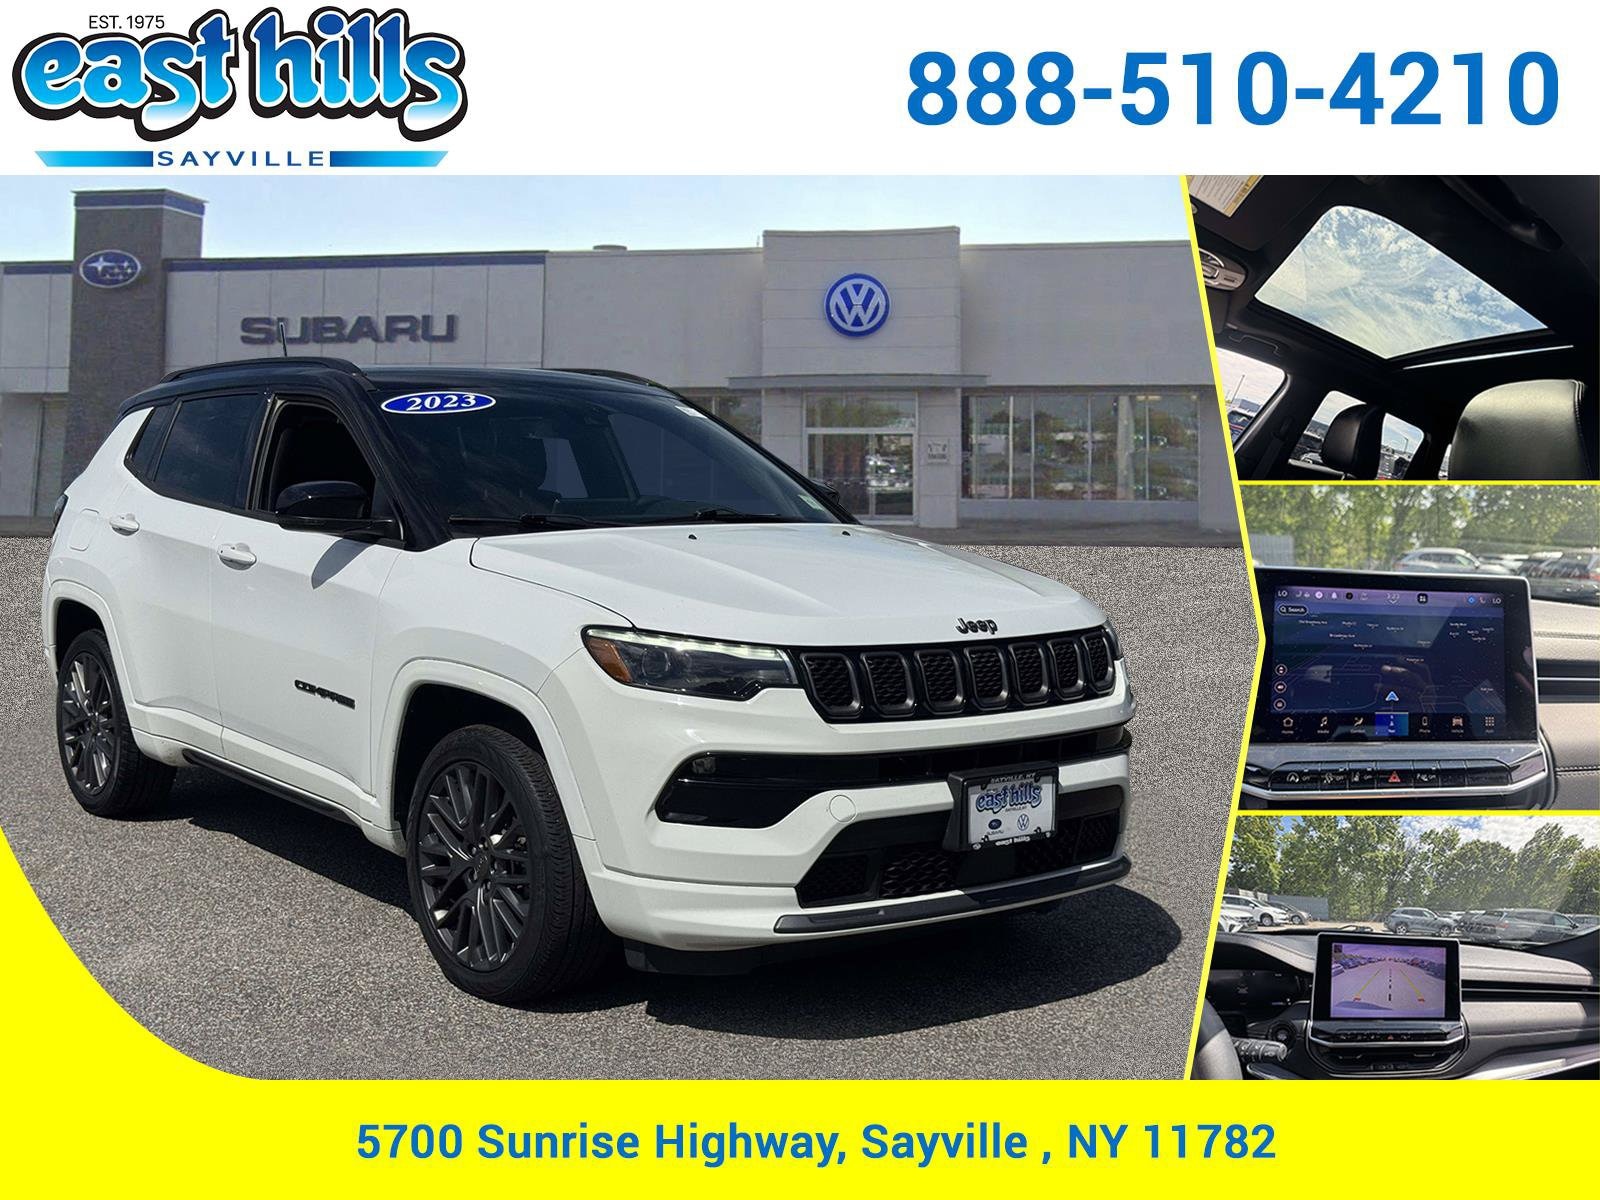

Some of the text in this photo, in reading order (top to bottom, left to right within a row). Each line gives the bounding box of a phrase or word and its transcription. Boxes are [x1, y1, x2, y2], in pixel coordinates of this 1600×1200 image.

[240, 314, 458, 345] SUBARU
[406, 393, 477, 411] 2023
[955, 617, 998, 635] Jeep
[976, 783, 1042, 814] east hills
